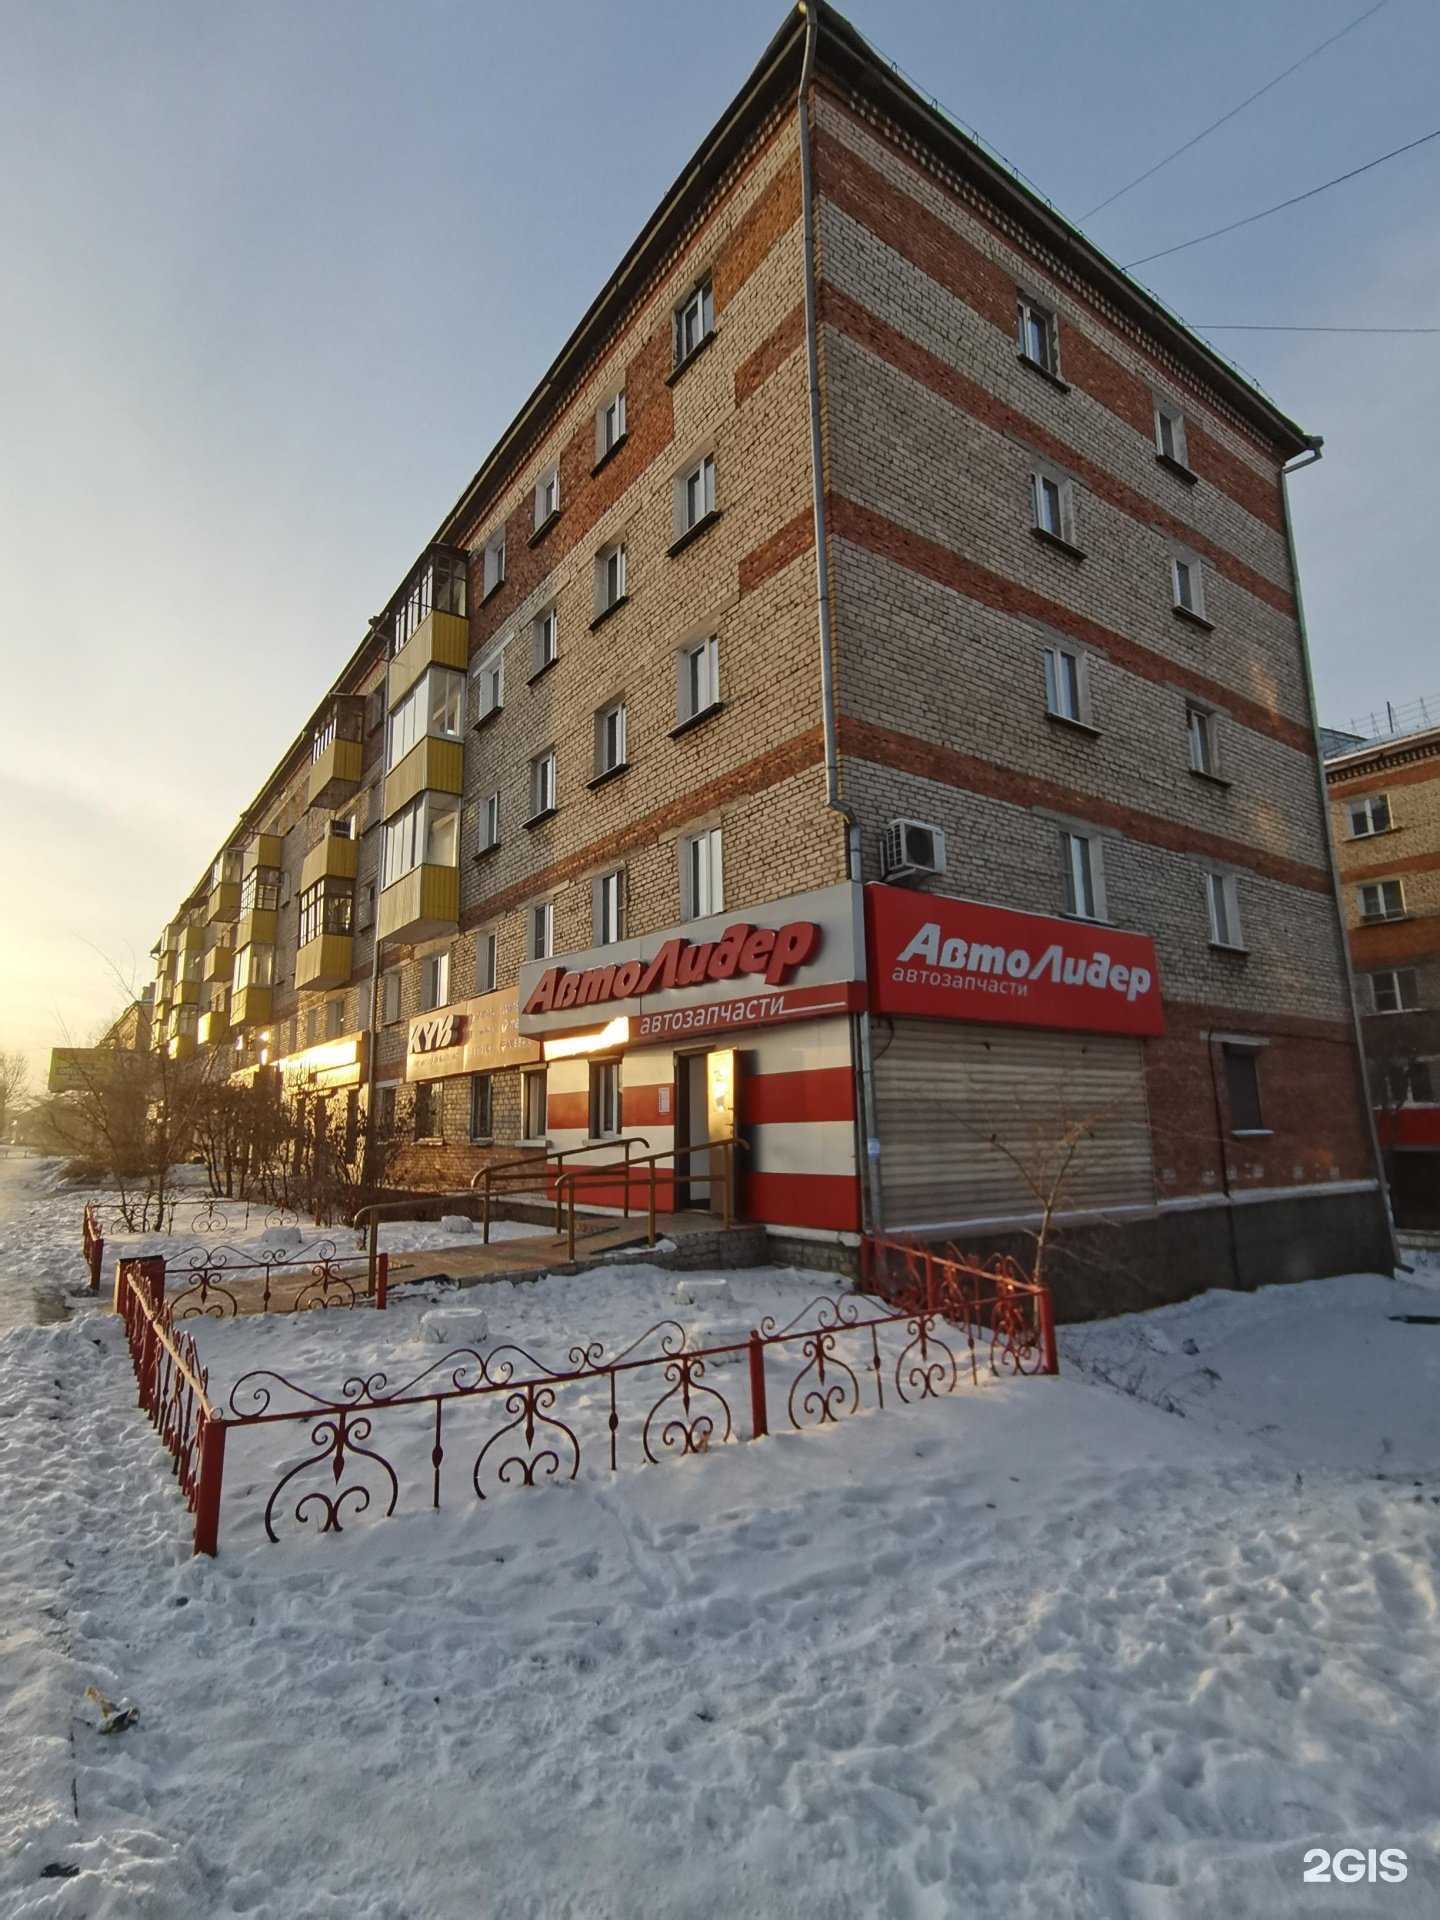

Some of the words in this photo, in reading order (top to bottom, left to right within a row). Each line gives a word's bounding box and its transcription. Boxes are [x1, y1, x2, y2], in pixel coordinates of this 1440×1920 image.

[522, 921, 821, 1014] АвтоЛидер
[892, 967, 1028, 997] автозапчасти
[896, 923, 1151, 1001] АвтоЛидер
[408, 1014, 456, 1054] KYB
[639, 995, 785, 1036] автозапчасти
